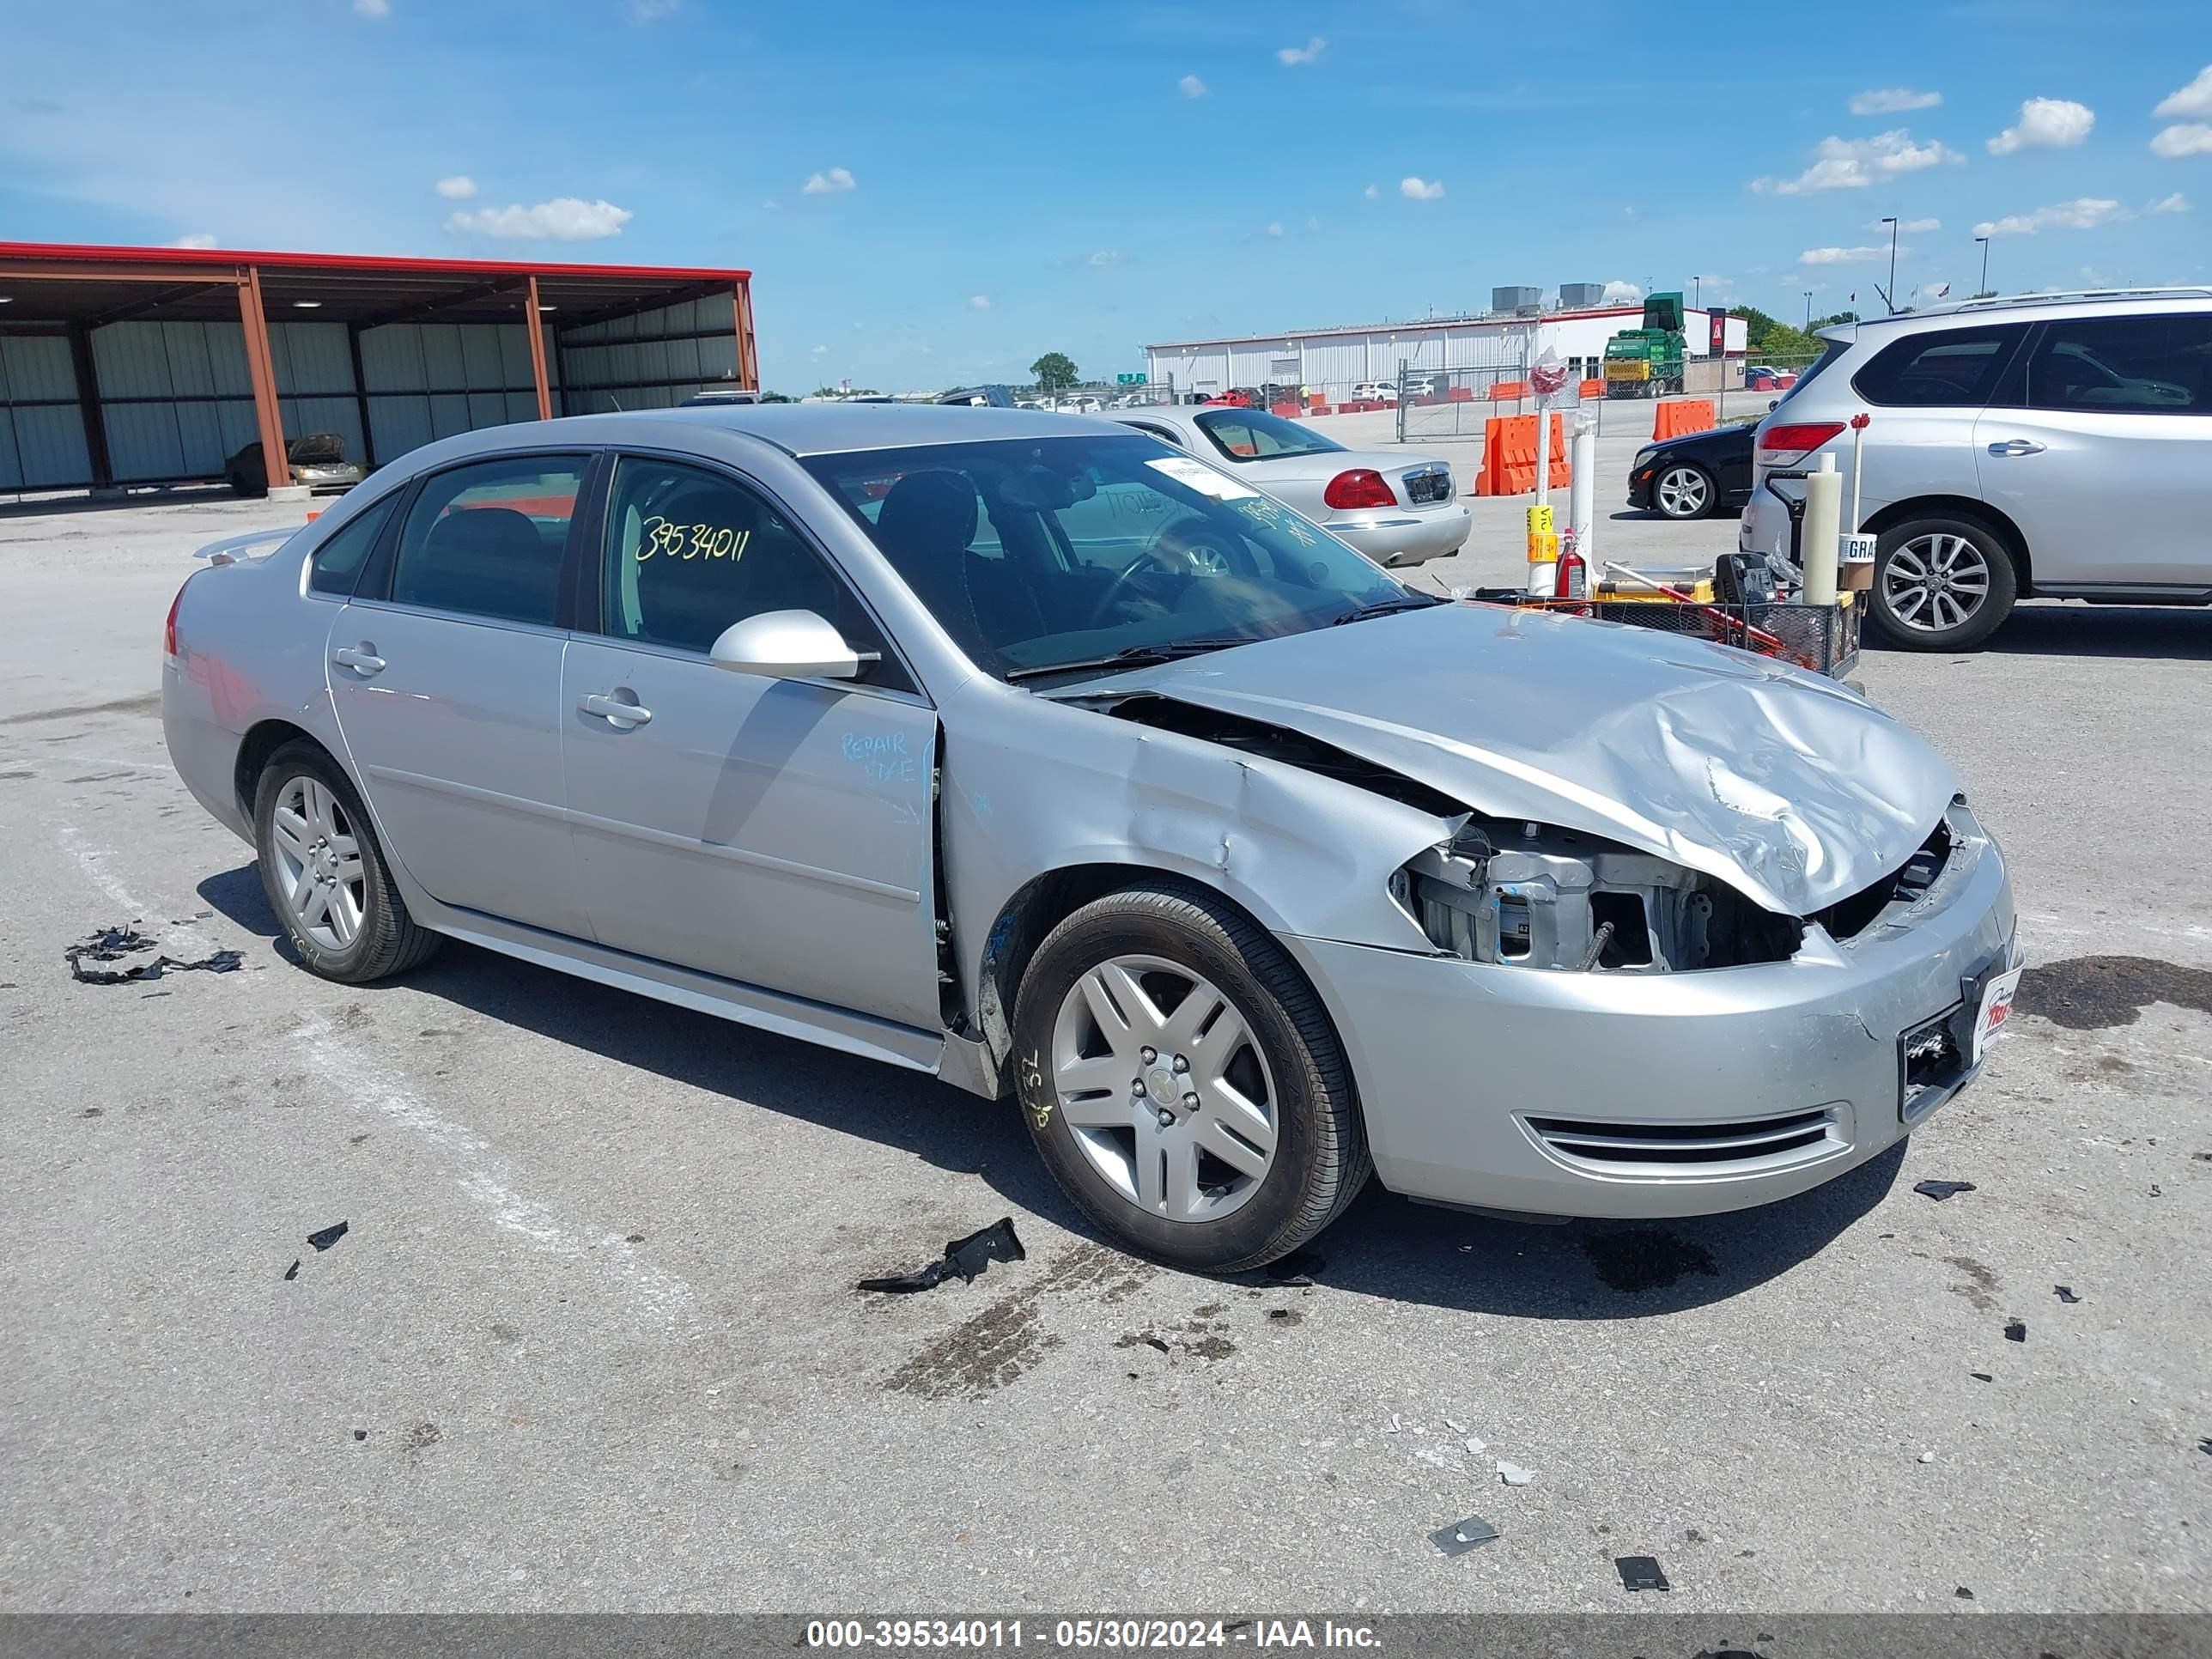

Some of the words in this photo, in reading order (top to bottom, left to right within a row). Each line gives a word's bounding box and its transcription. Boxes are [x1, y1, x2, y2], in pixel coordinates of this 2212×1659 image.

[635, 515, 750, 562] 39534011
[1850, 541, 1877, 558] GRA
[842, 732, 908, 759] REPAIR
